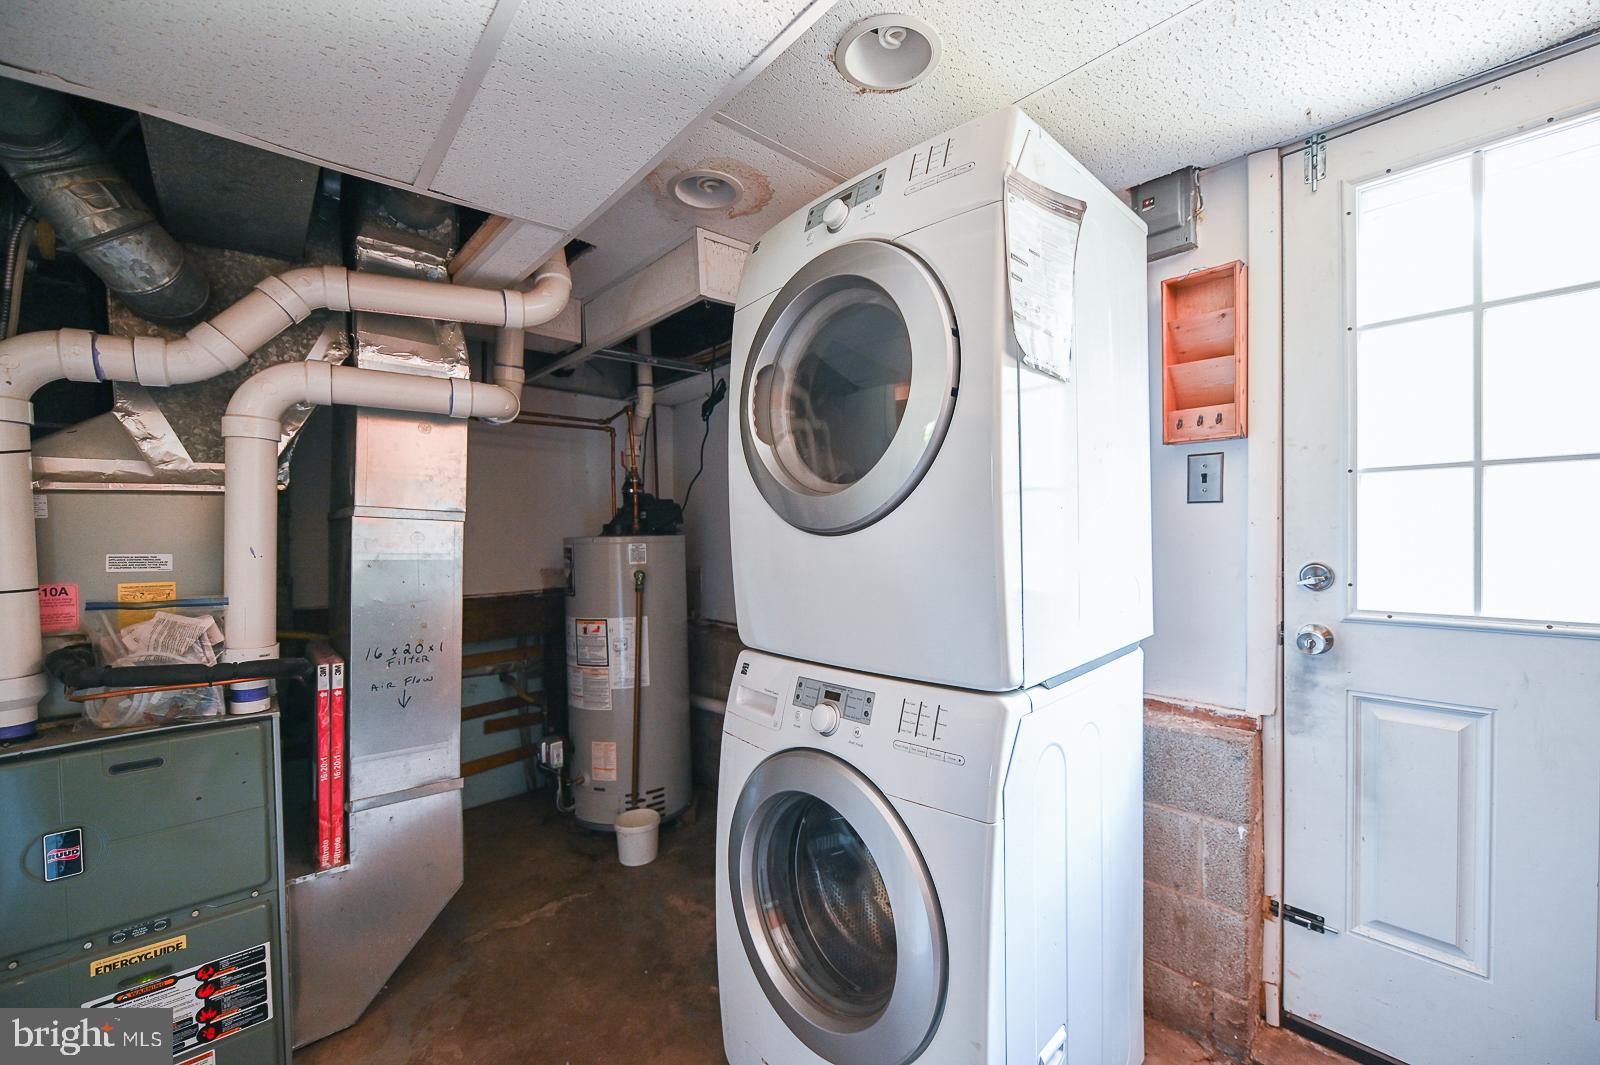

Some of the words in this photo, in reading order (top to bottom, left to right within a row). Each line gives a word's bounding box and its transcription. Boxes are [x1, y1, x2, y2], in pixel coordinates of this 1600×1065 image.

[320, 666, 327, 677] 3M
[334, 664, 341, 676] 3M
[48, 849, 80, 861] RUUD
